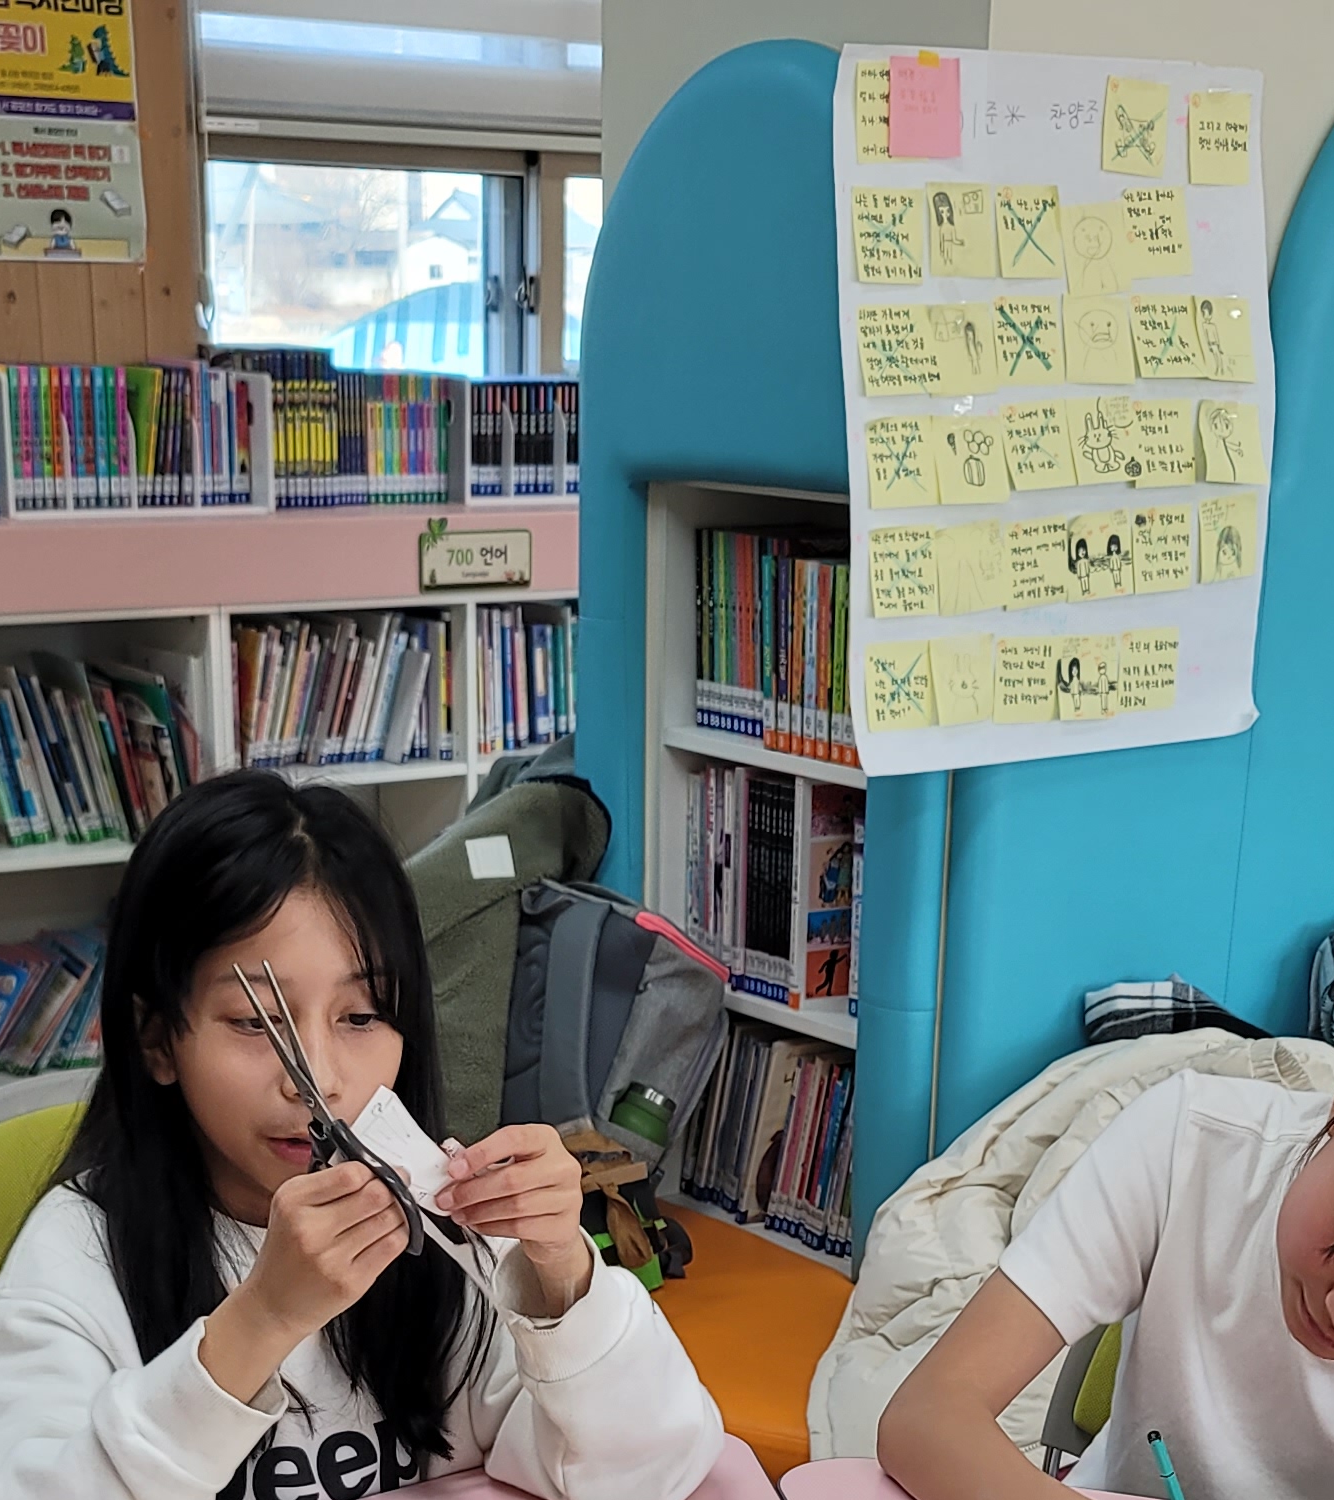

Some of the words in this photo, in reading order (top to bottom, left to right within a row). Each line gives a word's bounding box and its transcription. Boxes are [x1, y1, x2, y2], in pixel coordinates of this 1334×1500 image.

[1050, 100, 1099, 130] 찬양조
[447, 548, 474, 566] 700
[480, 544, 508, 567] 언어
